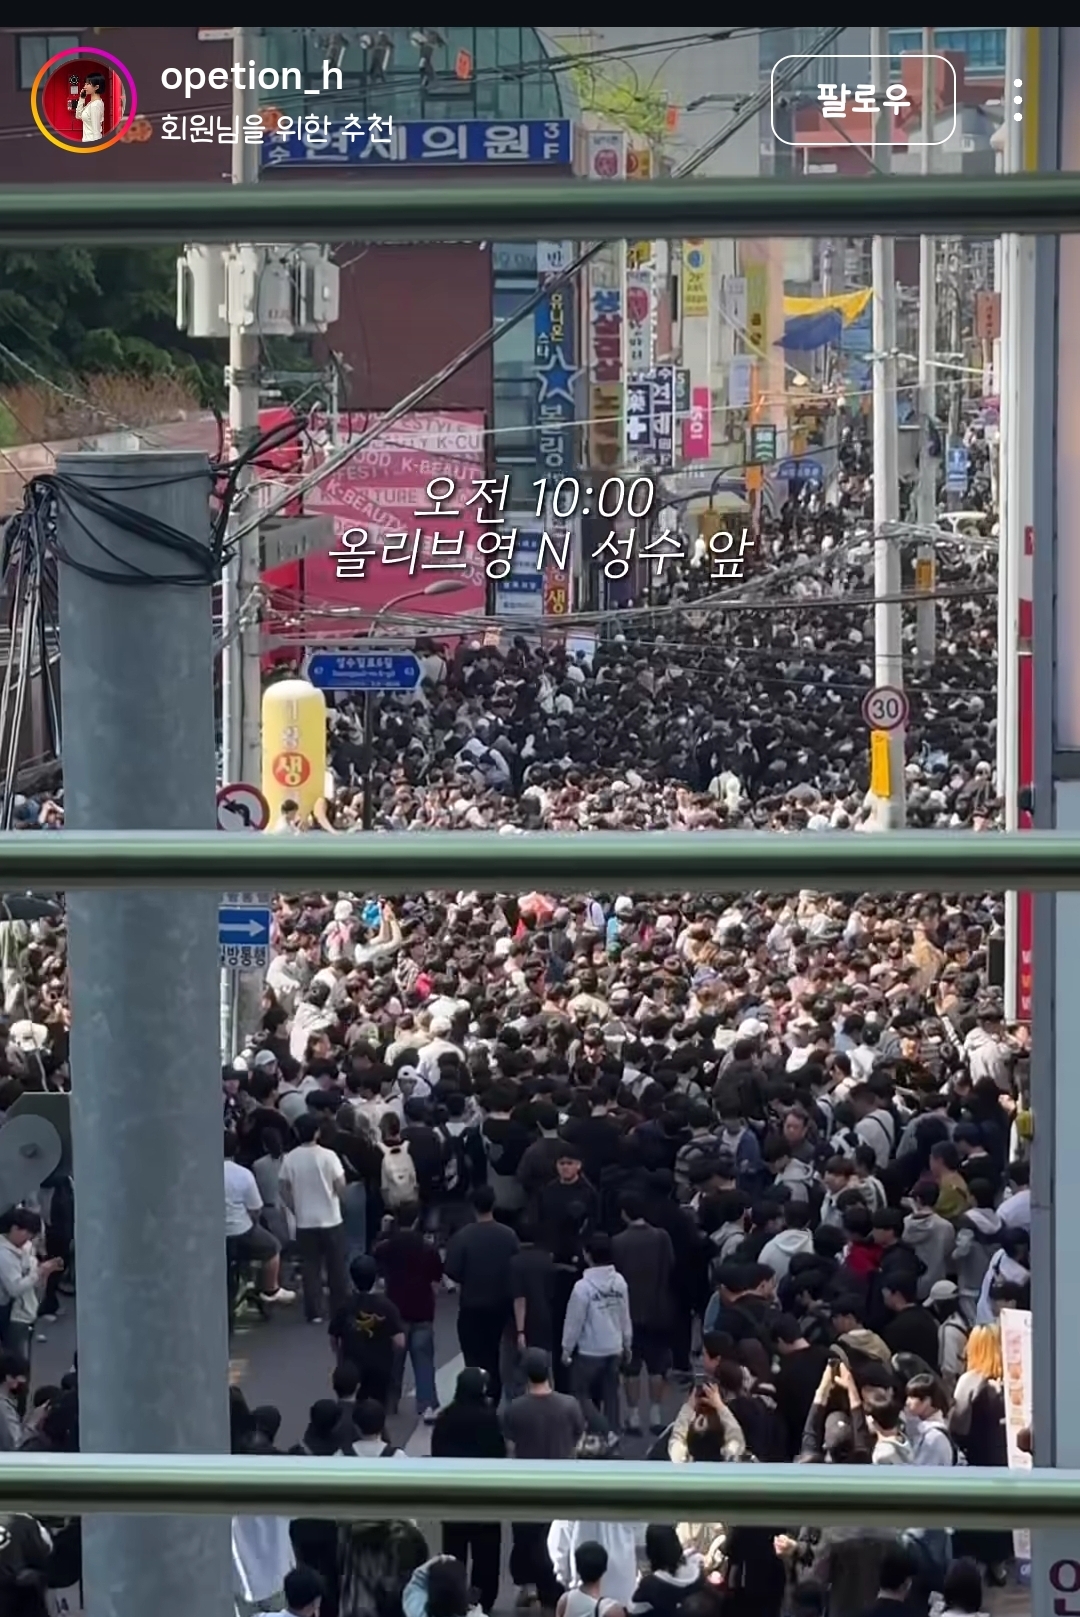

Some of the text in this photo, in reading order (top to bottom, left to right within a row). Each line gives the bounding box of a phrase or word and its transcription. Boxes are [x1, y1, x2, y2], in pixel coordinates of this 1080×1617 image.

[352, 451, 392, 468] OOD
[326, 479, 408, 532] K-BEAUTY
[872, 697, 899, 720] 30
